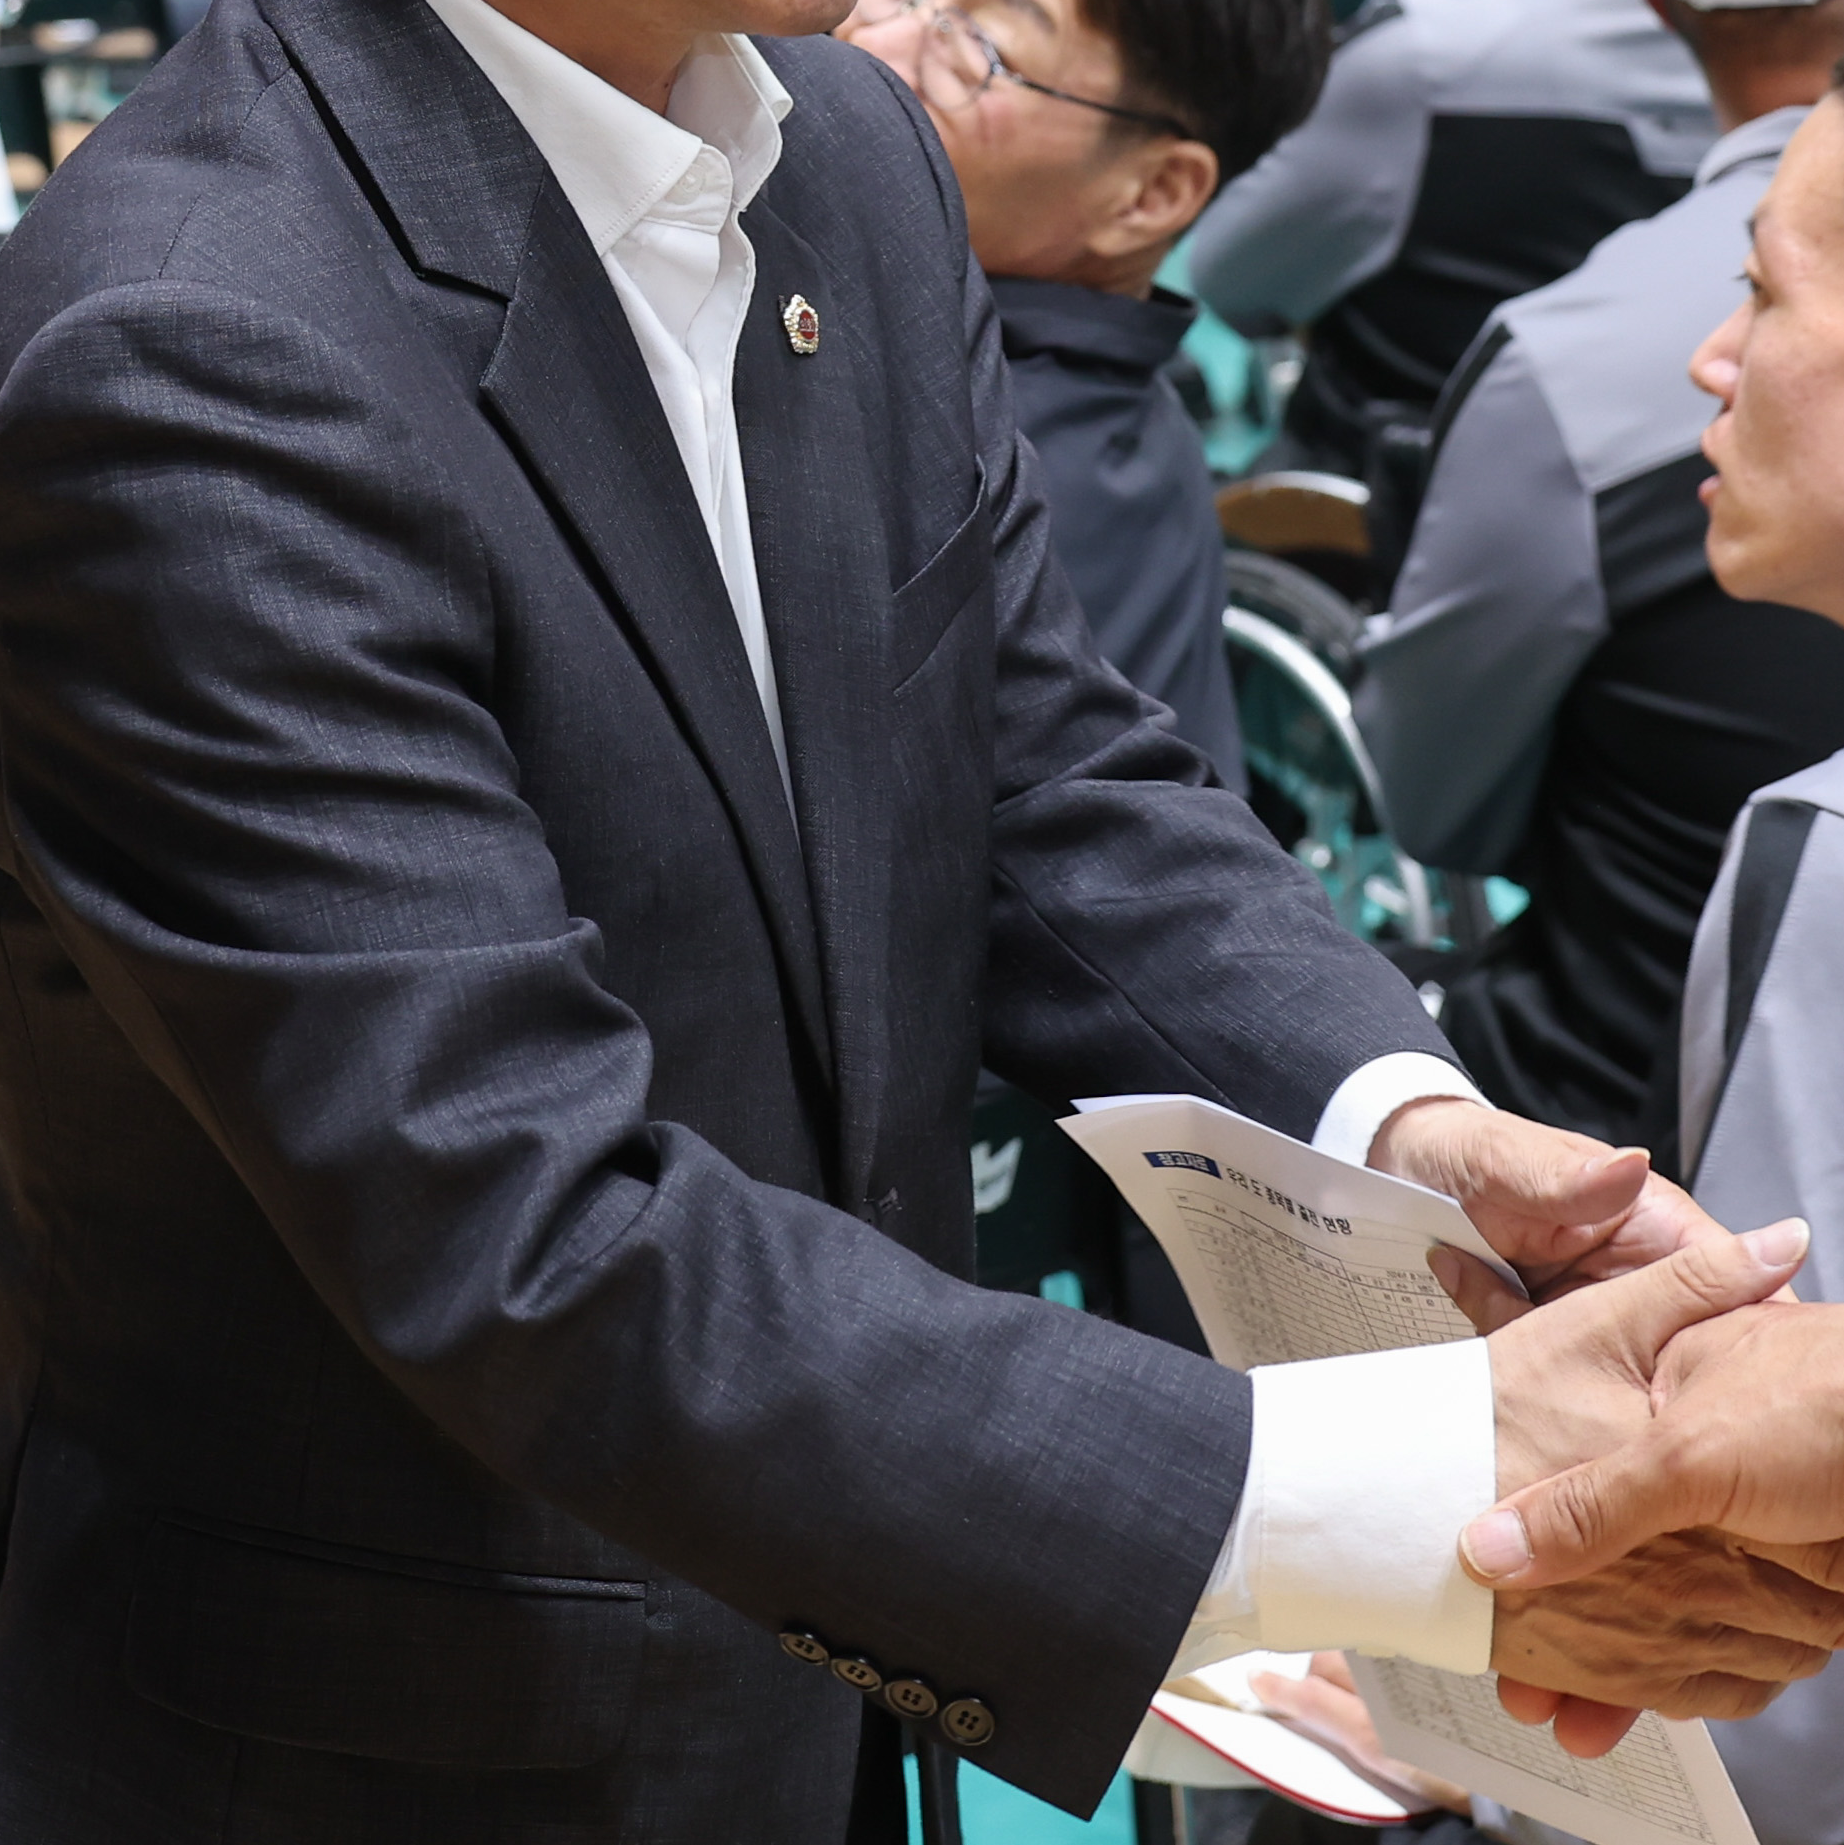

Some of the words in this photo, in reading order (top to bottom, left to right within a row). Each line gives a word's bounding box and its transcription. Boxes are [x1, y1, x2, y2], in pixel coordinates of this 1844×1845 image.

[1226, 1168, 1249, 1190] 우리
[1250, 1178, 1264, 1198] 도
[1322, 1216, 1353, 1236] 현황
